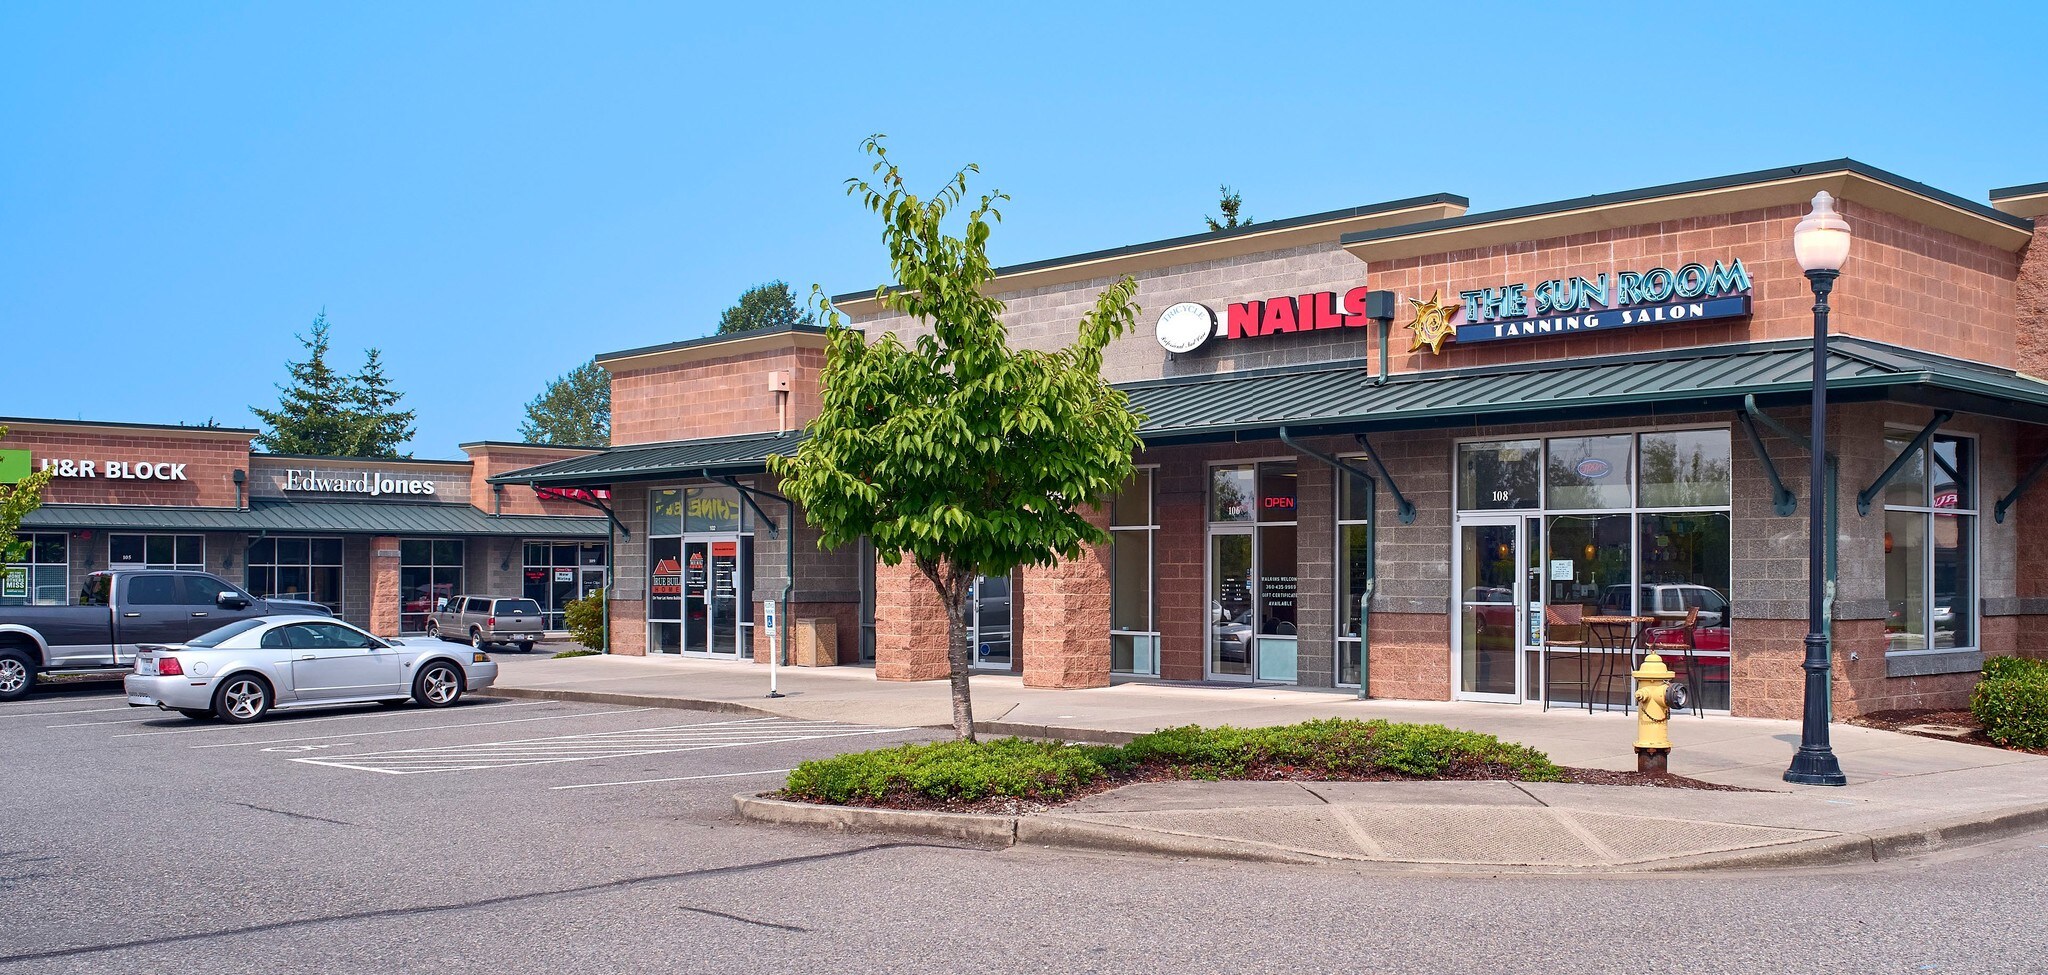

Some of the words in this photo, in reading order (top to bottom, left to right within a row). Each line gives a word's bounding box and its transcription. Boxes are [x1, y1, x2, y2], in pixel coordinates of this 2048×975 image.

[1460, 283, 1528, 322] THE
[1534, 272, 1609, 315] SUN
[1618, 257, 1752, 305] ROOM
[1162, 304, 1206, 322] TRICYCLE
[1227, 285, 1367, 340] NAILS
[1494, 315, 1599, 337] TANNING
[1622, 303, 1704, 324] SALON
[42, 458, 96, 478] H&R
[105, 460, 187, 481] BLOCK
[285, 468, 369, 492] Edward
[371, 472, 435, 496] Jones
[1264, 497, 1294, 508] OPEN
[1492, 490, 1509, 502] 108
[1228, 506, 1241, 516] 106
